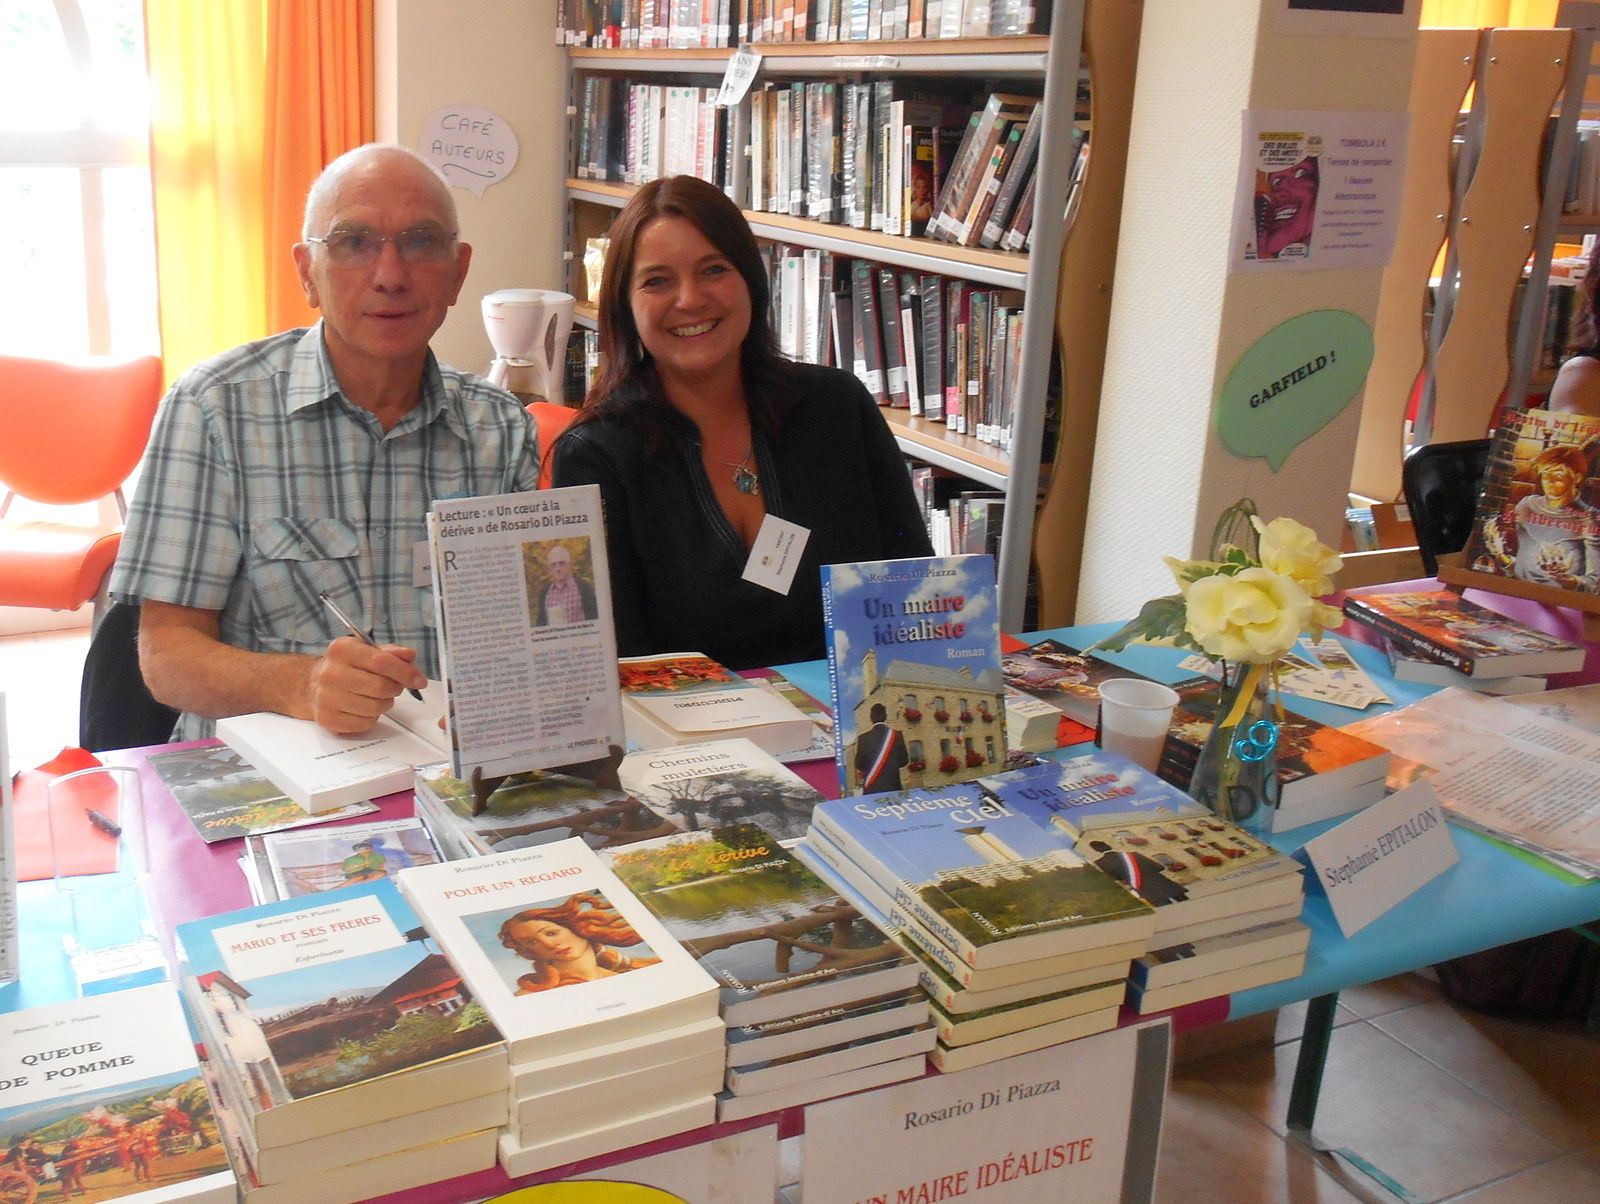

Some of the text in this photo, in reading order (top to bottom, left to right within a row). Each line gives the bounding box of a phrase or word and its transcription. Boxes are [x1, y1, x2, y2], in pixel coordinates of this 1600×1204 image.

[441, 112, 495, 136] CAFÉ
[431, 139, 505, 165] AUTEURS
[1250, 355, 1328, 408] GARFIELD
[439, 507, 480, 522] Lecture
[496, 505, 512, 517] Un
[513, 502, 539, 514] cœur
[542, 501, 549, 511] à
[551, 500, 560, 511] la
[441, 523, 476, 538] dérive
[486, 521, 499, 533] de
[501, 517, 540, 532] Rosario
[542, 515, 554, 527] Di
[555, 513, 589, 526] Piazza
[868, 568, 957, 584] Rosario Di Piazza
[864, 592, 966, 619] Un maire
[874, 619, 966, 647] idéaliste
[947, 647, 985, 659] Roman
[649, 751, 731, 770] Chemins
[661, 762, 749, 781] muletiers
[1017, 786, 1056, 801] Un
[1057, 772, 1120, 792] maire
[1043, 784, 1137, 812] idéaliste
[854, 794, 974, 821] Septième
[1377, 807, 1439, 857] EPITALON
[454, 853, 543, 874] Rosario Di Piazza
[706, 846, 770, 865] dérive
[443, 866, 583, 900] POUR UN REGARD
[255, 907, 342, 929] Rosario Di Piazza
[893, 885, 961, 954] Septième ciel
[231, 935, 276, 954] MARIO
[280, 929, 297, 943] ET
[300, 924, 327, 938] SES
[21, 1041, 103, 1067] QUEUE
[45, 1054, 136, 1081] POMME
[904, 1078, 1061, 1131] Rosario Di Piazza
[897, 1170, 969, 1204] MAIRE
[977, 1137, 1093, 1190] IDÉALISTE
